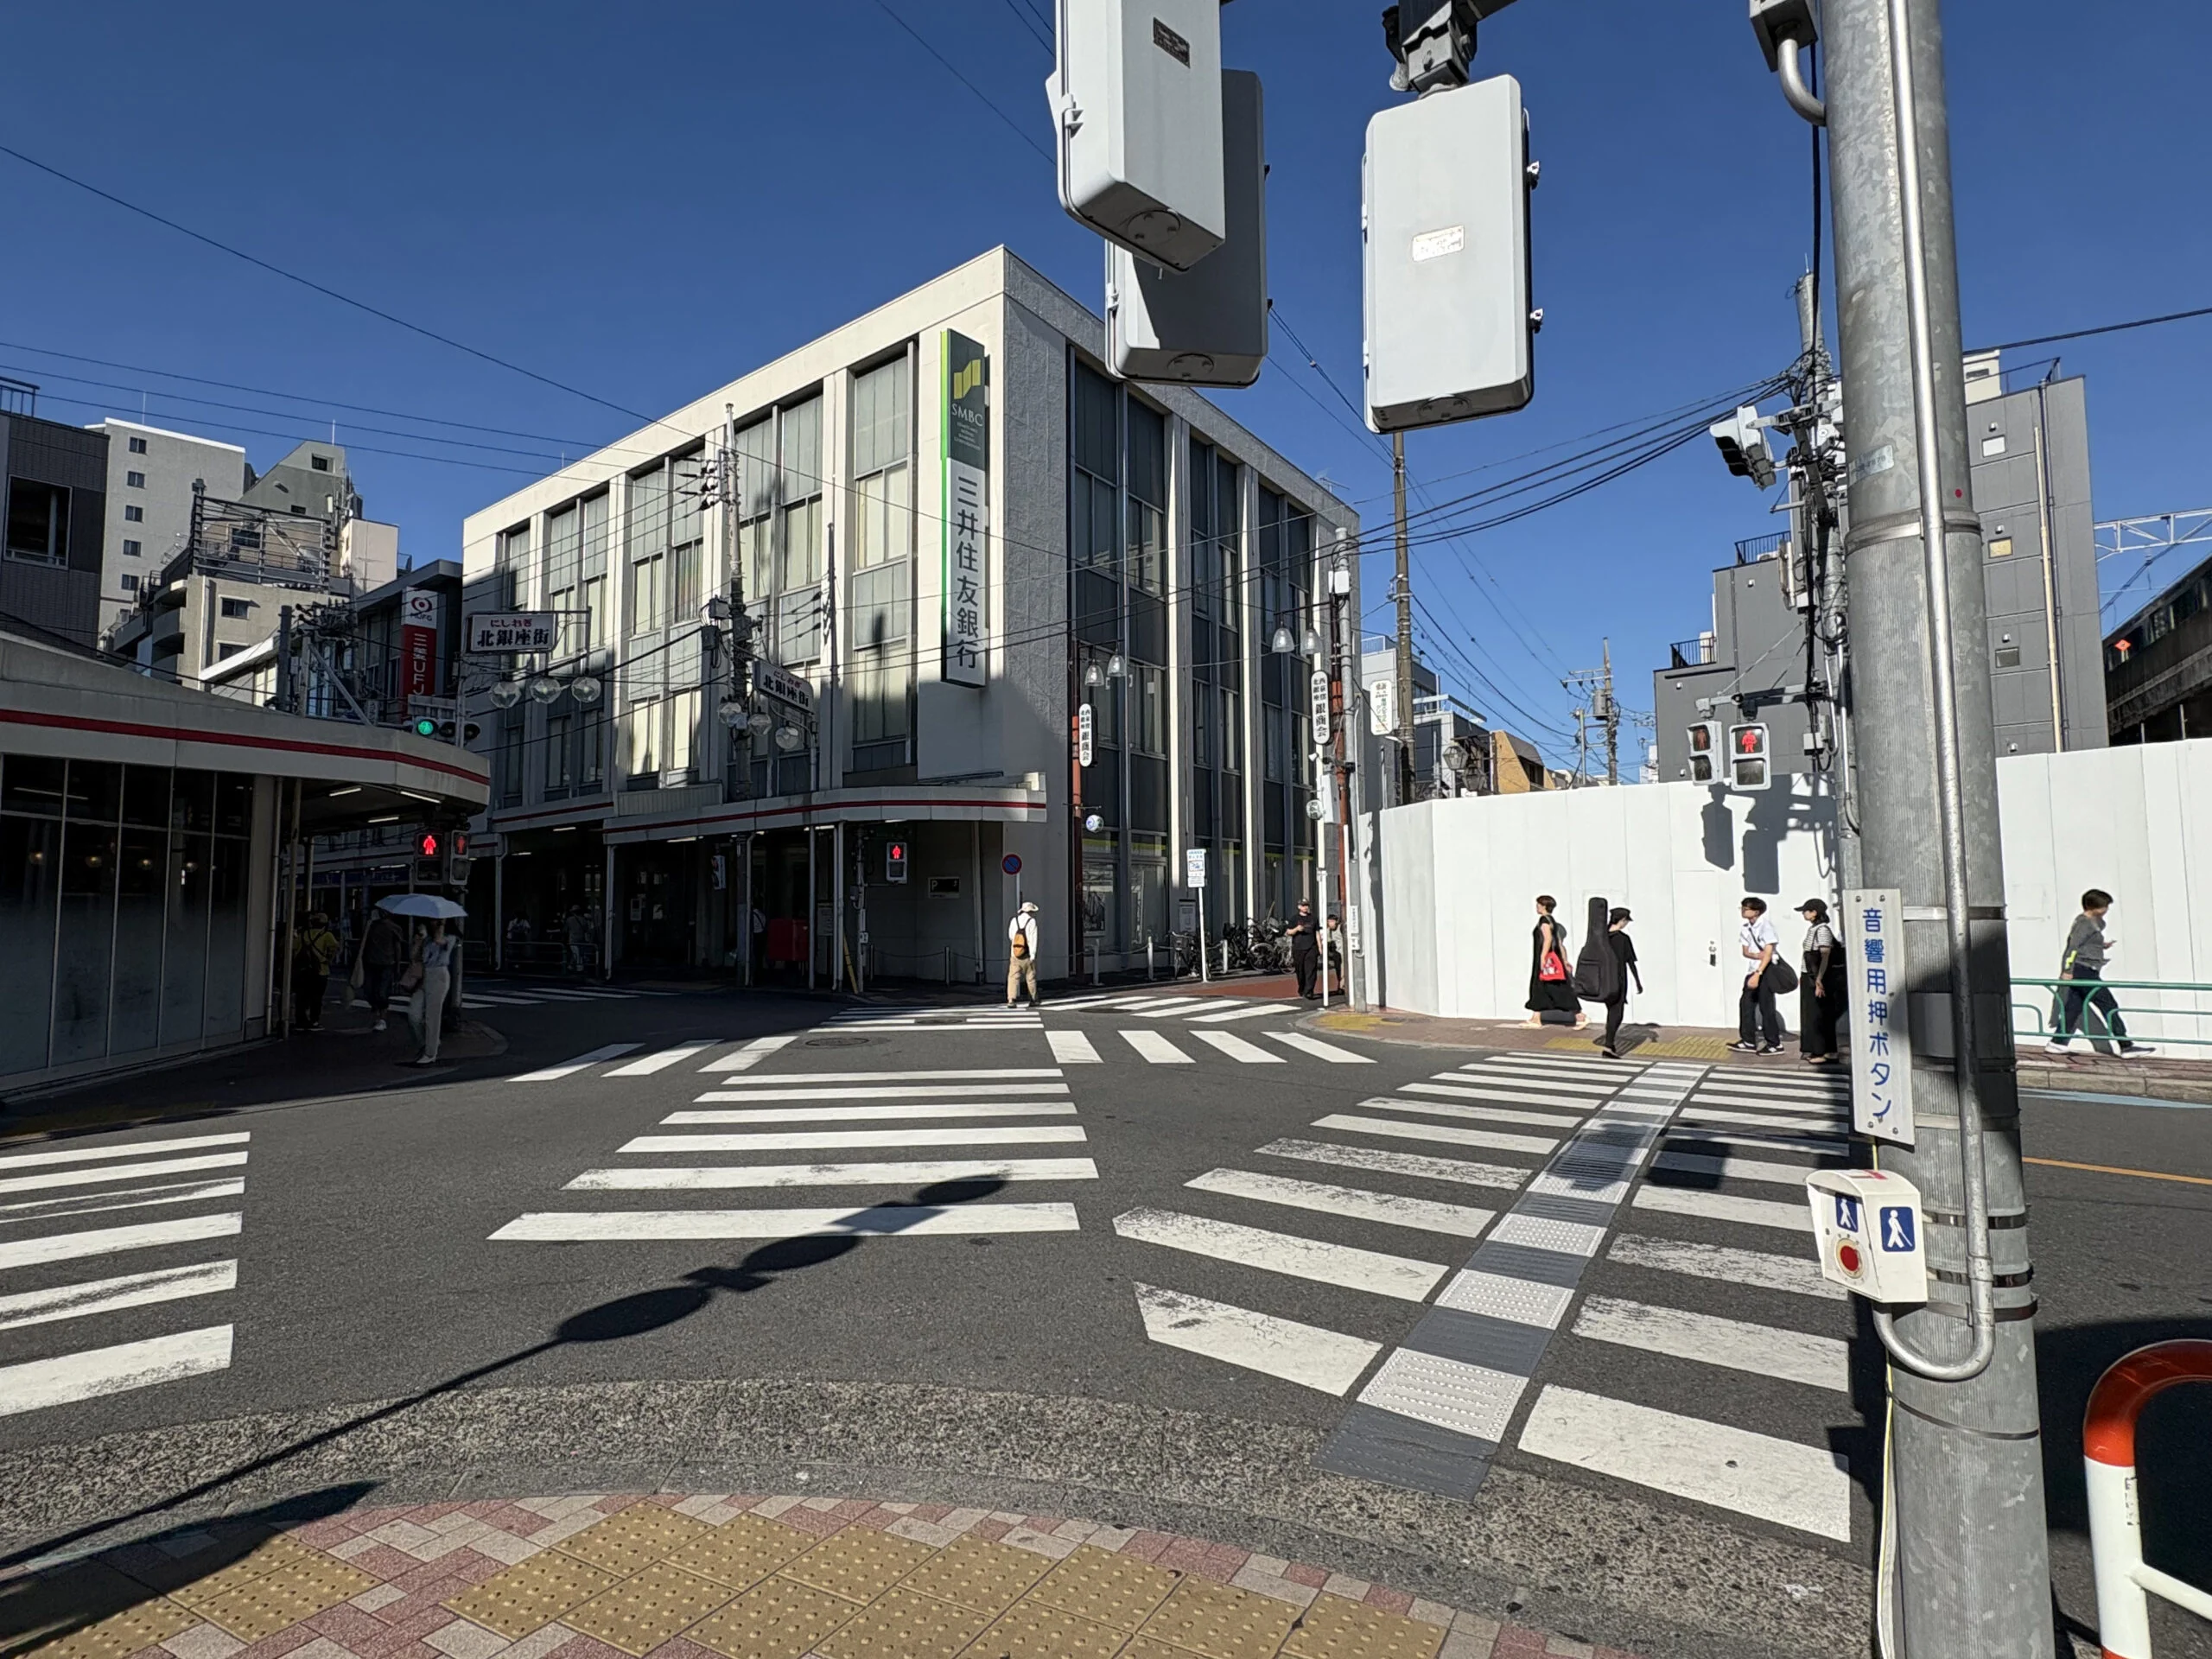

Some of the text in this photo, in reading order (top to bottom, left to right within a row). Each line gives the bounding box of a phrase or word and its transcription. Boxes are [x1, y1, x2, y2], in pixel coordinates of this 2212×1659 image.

[951, 403, 983, 427] SMBC
[956, 476, 979, 670] 三井住友銀行
[477, 628, 550, 647] 北銀座街
[931, 880, 938, 891] P
[1863, 908, 1891, 1117] 音響用押ボタン
